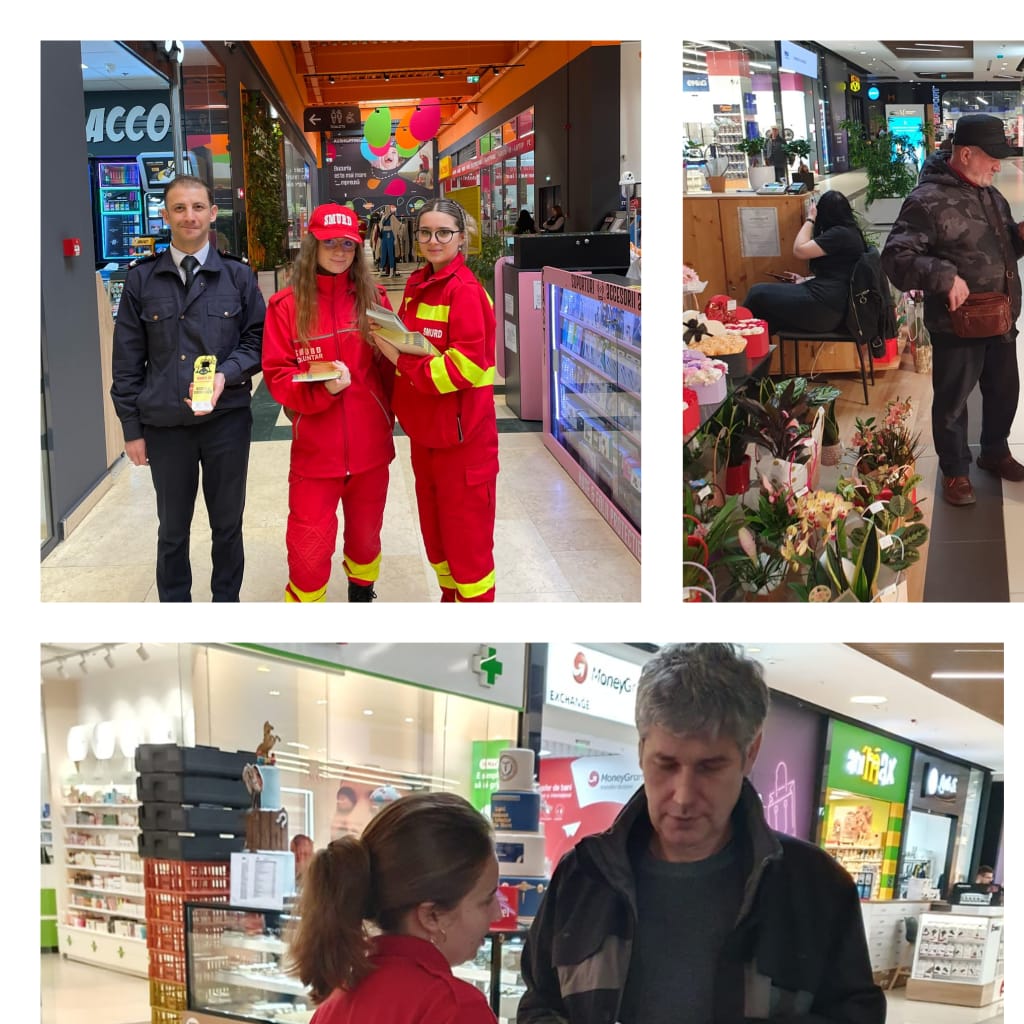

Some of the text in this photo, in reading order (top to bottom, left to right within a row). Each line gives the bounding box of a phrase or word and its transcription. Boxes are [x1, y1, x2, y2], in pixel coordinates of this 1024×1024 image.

[86, 103, 170, 142] ACCO
[323, 213, 353, 227] SMURD
[423, 327, 443, 339] SMURD
[296, 352, 324, 364] OLUNTAR
[549, 690, 591, 710] EXCHANGE
